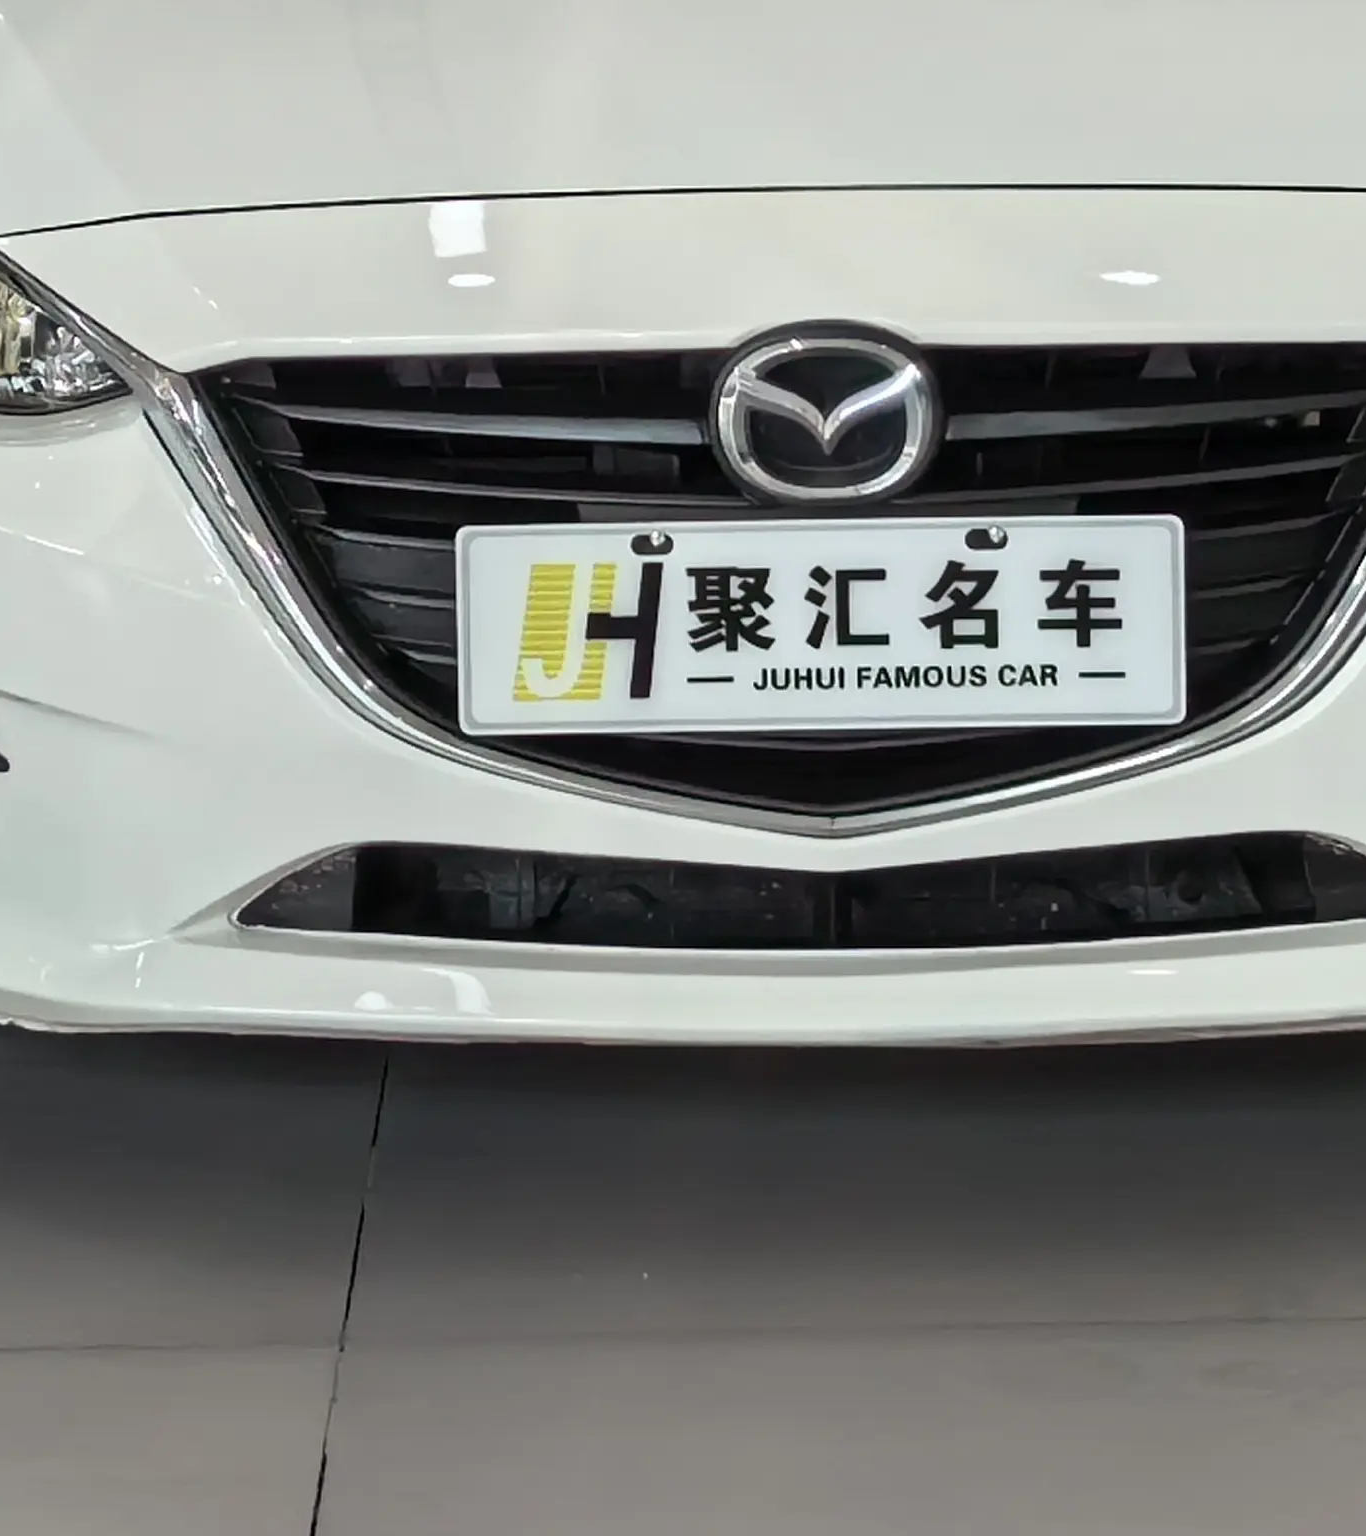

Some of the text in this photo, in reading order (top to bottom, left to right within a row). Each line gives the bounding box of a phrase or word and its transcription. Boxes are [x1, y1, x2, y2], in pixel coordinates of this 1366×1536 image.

[686, 558, 1124, 654] 聚汇名车
[753, 663, 1058, 692] JUHUI FAMOUS CAR
